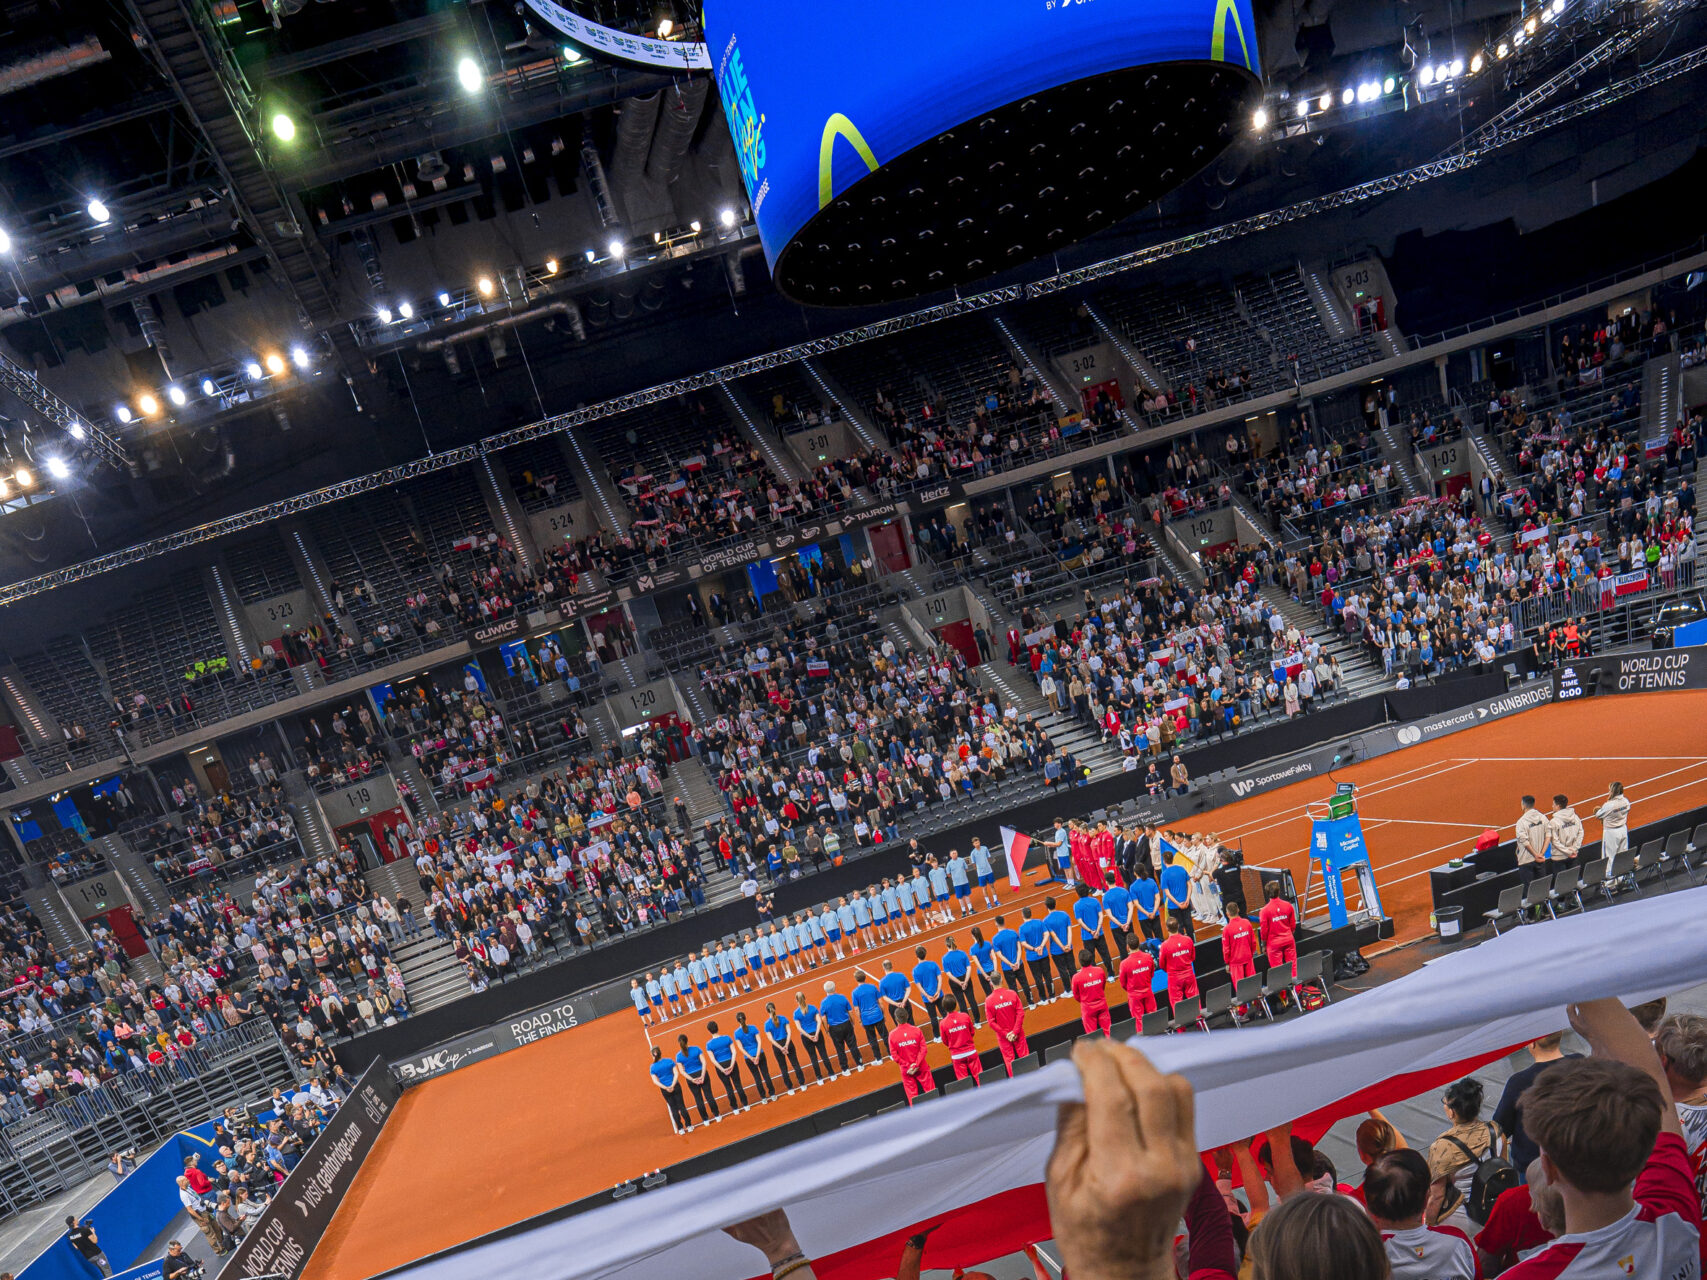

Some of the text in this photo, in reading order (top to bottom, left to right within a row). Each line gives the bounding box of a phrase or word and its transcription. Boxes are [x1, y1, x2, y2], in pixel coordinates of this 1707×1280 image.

[1346, 270, 1369, 288] 3-03
[1073, 355, 1096, 372] 3-02
[808, 435, 829, 450] 3-01
[1432, 449, 1456, 467] 1-03
[921, 486, 950, 500] Hertz
[550, 512, 574, 530] 3-24
[855, 504, 895, 521] TAURON
[1191, 519, 1215, 537] 1-02
[700, 542, 755, 565] WORLD CUP
[703, 550, 758, 573] OF TENNIS
[268, 603, 293, 620] 3-23
[926, 597, 947, 615] 1-01
[474, 619, 519, 640] GLIWICE
[1621, 654, 1689, 674] WORLD CUP
[1561, 679, 1578, 688] TIME
[1618, 670, 1686, 690] OF TENNIS
[631, 690, 655, 709] 1-20
[1490, 686, 1552, 715] GAINBRIDGE
[1560, 687, 1582, 699] 0:00
[1424, 711, 1475, 734] mastercard
[1230, 763, 1312, 797] WP SportoweFakty
[347, 788, 371, 807] 1-19
[81, 882, 107, 902] 1-18
[510, 1005, 574, 1036] ROAD TO
[515, 1016, 578, 1046] THE FINALS
[400, 1052, 443, 1078] BJK
[302, 1122, 362, 1209] visit gainbridge.com
[242, 1218, 286, 1277] WORLD CUP
[270, 1237, 304, 1280] TENNIS
[142, 1270, 161, 1279] TENNIS
